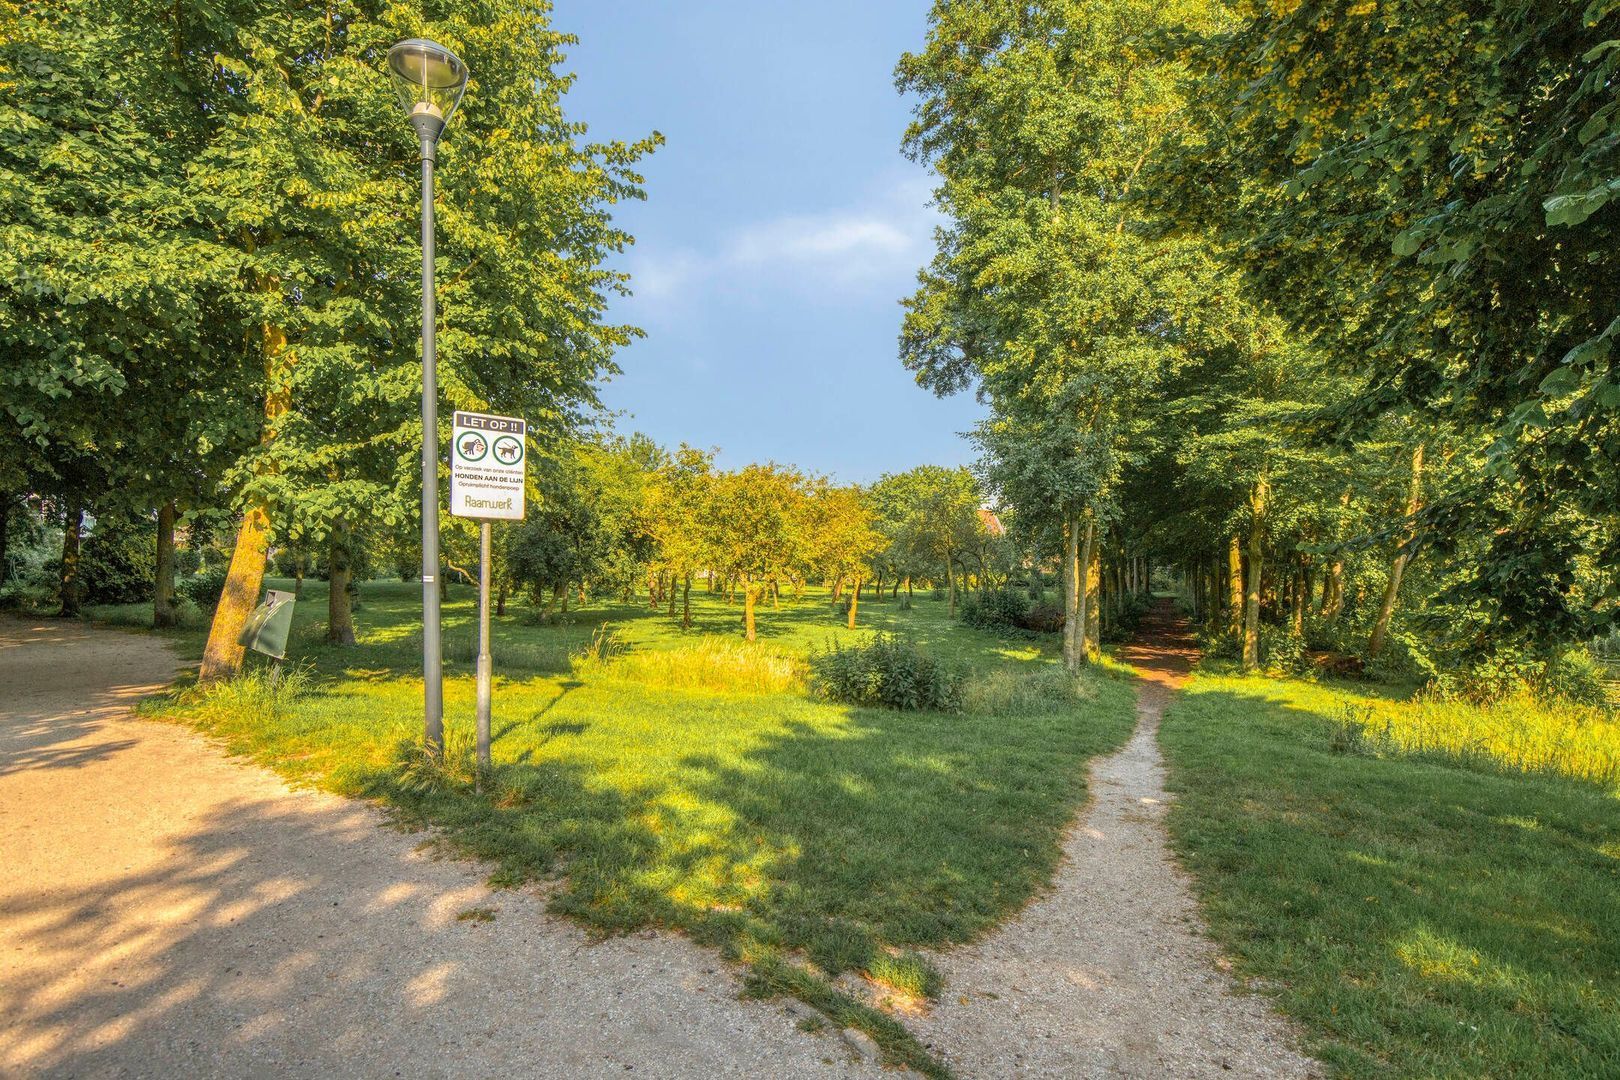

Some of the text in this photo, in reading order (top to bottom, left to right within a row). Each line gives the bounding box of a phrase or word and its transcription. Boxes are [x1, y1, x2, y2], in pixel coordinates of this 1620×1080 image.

[463, 416, 518, 432] LET OP !!
[455, 473, 484, 481] HONDEN
[465, 495, 513, 510] Raamwerk
